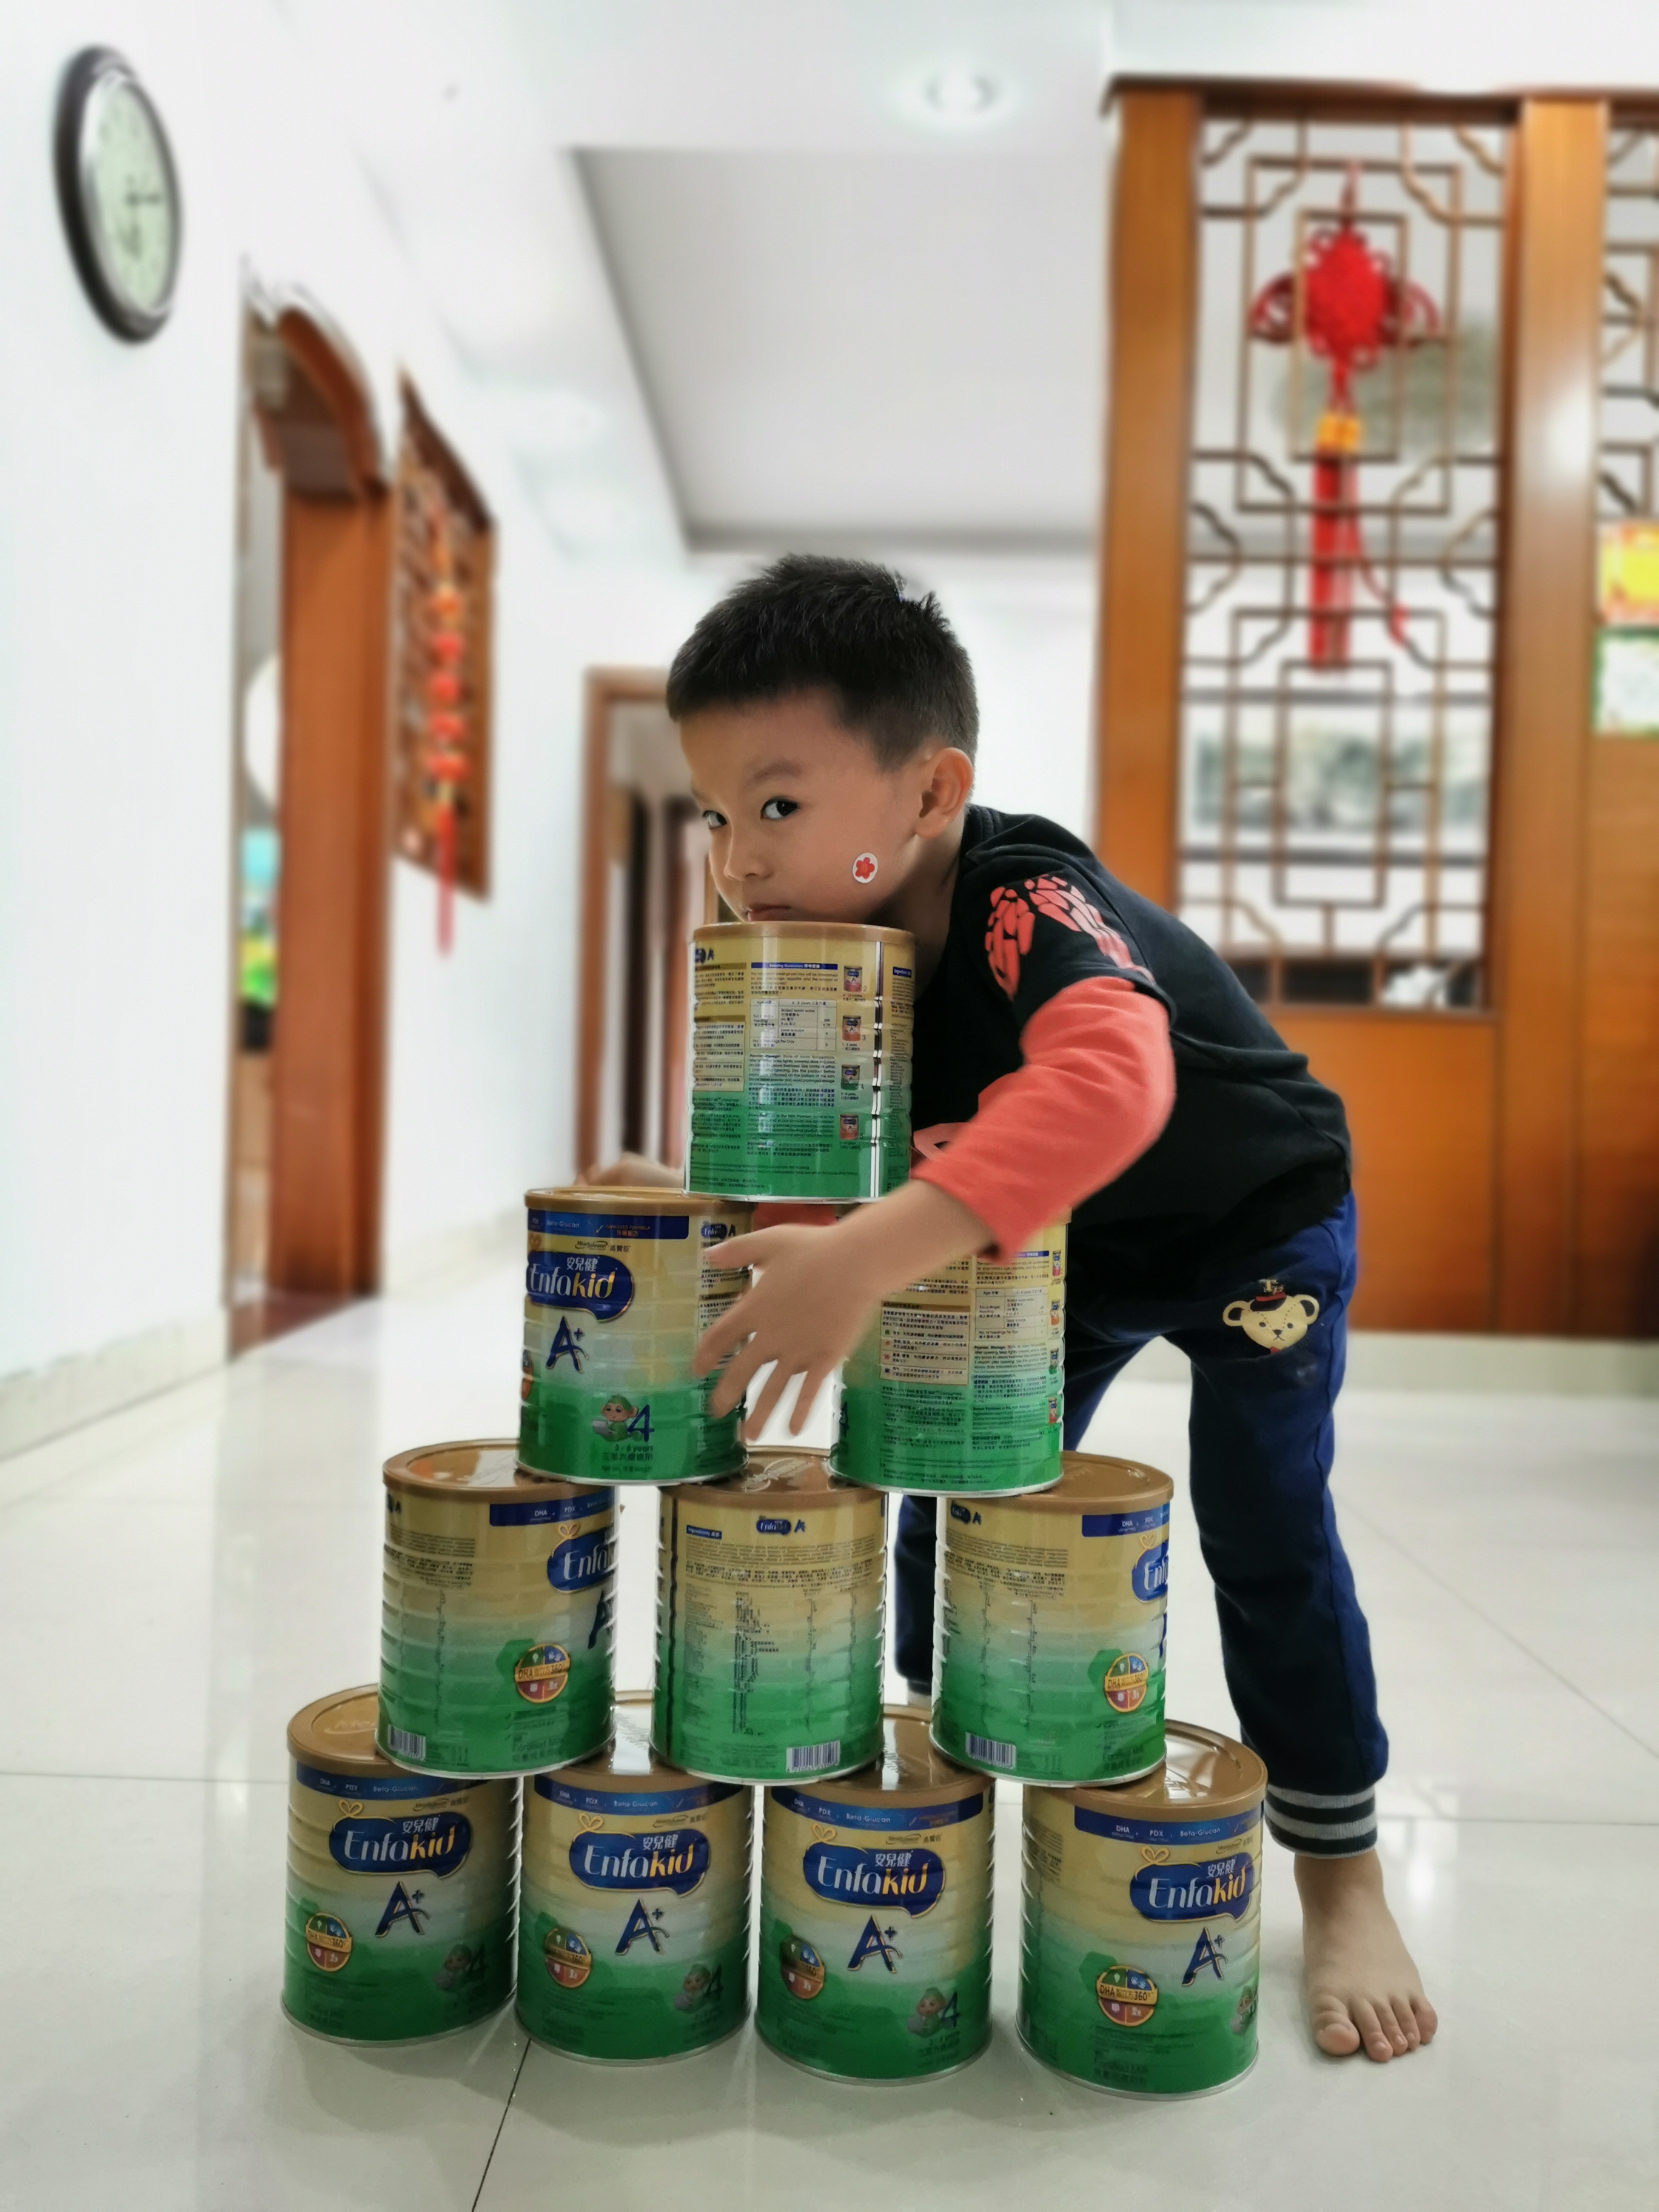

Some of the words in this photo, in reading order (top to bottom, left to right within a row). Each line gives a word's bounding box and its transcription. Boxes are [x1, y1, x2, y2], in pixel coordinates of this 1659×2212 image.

[547, 1220, 580, 1228] Beta-Glucan
[566, 1256, 598, 1272] 安兒健
[530, 1263, 616, 1299] Enfakid
[627, 1404, 654, 1443] 4
[563, 1543, 614, 1581] Enfa
[518, 1669, 533, 1680] DHA
[1108, 1678, 1121, 1689] DHA
[819, 1807, 831, 1816] PDX
[402, 1815, 440, 1834] 安兒健
[1116, 1825, 1130, 1834] DHA
[1180, 1828, 1221, 1837] Beta-Glucan
[344, 1825, 456, 1862] Enfakid
[643, 1834, 679, 1851] 安兒健
[583, 1843, 694, 1878] Enfakid
[875, 1852, 912, 1868] 安兒健
[1207, 1858, 1236, 1878] 安兒健
[818, 1855, 929, 1895] Enfakid
[1148, 1865, 1247, 1909] Enfakid
[1100, 1985, 1114, 1996] DHA
[940, 1991, 961, 2028] 4
